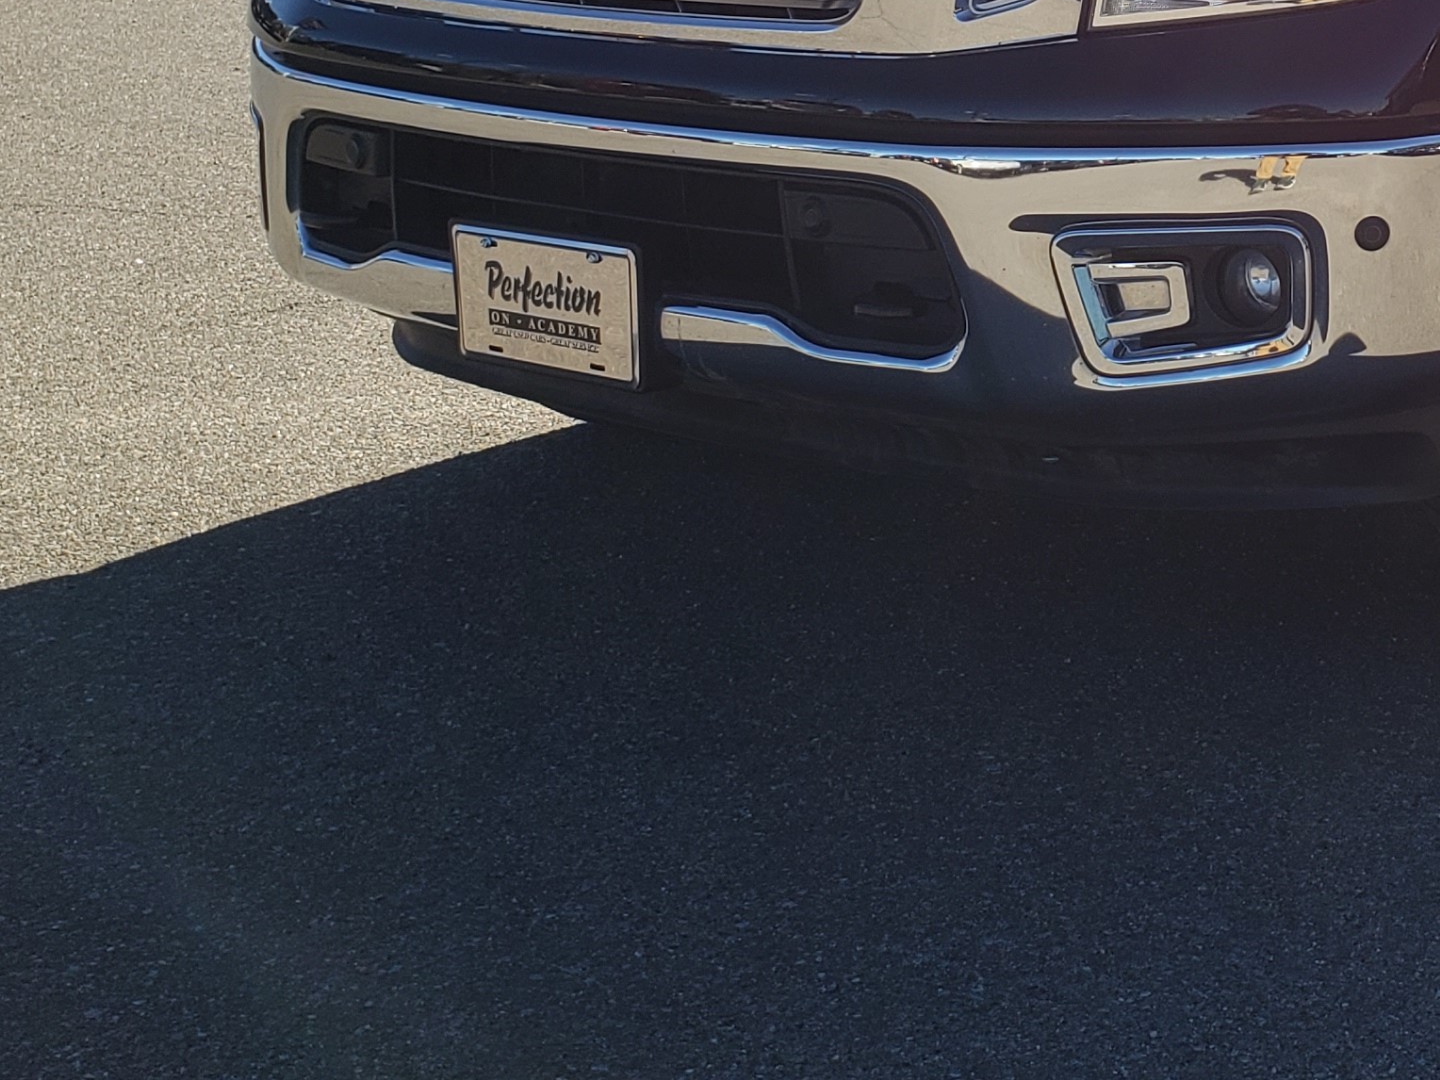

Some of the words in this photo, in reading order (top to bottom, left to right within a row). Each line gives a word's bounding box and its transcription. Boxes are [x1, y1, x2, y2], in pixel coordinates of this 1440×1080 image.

[484, 260, 602, 317] Perfection
[491, 311, 510, 325] ON
[528, 320, 599, 341] ACADEMY
